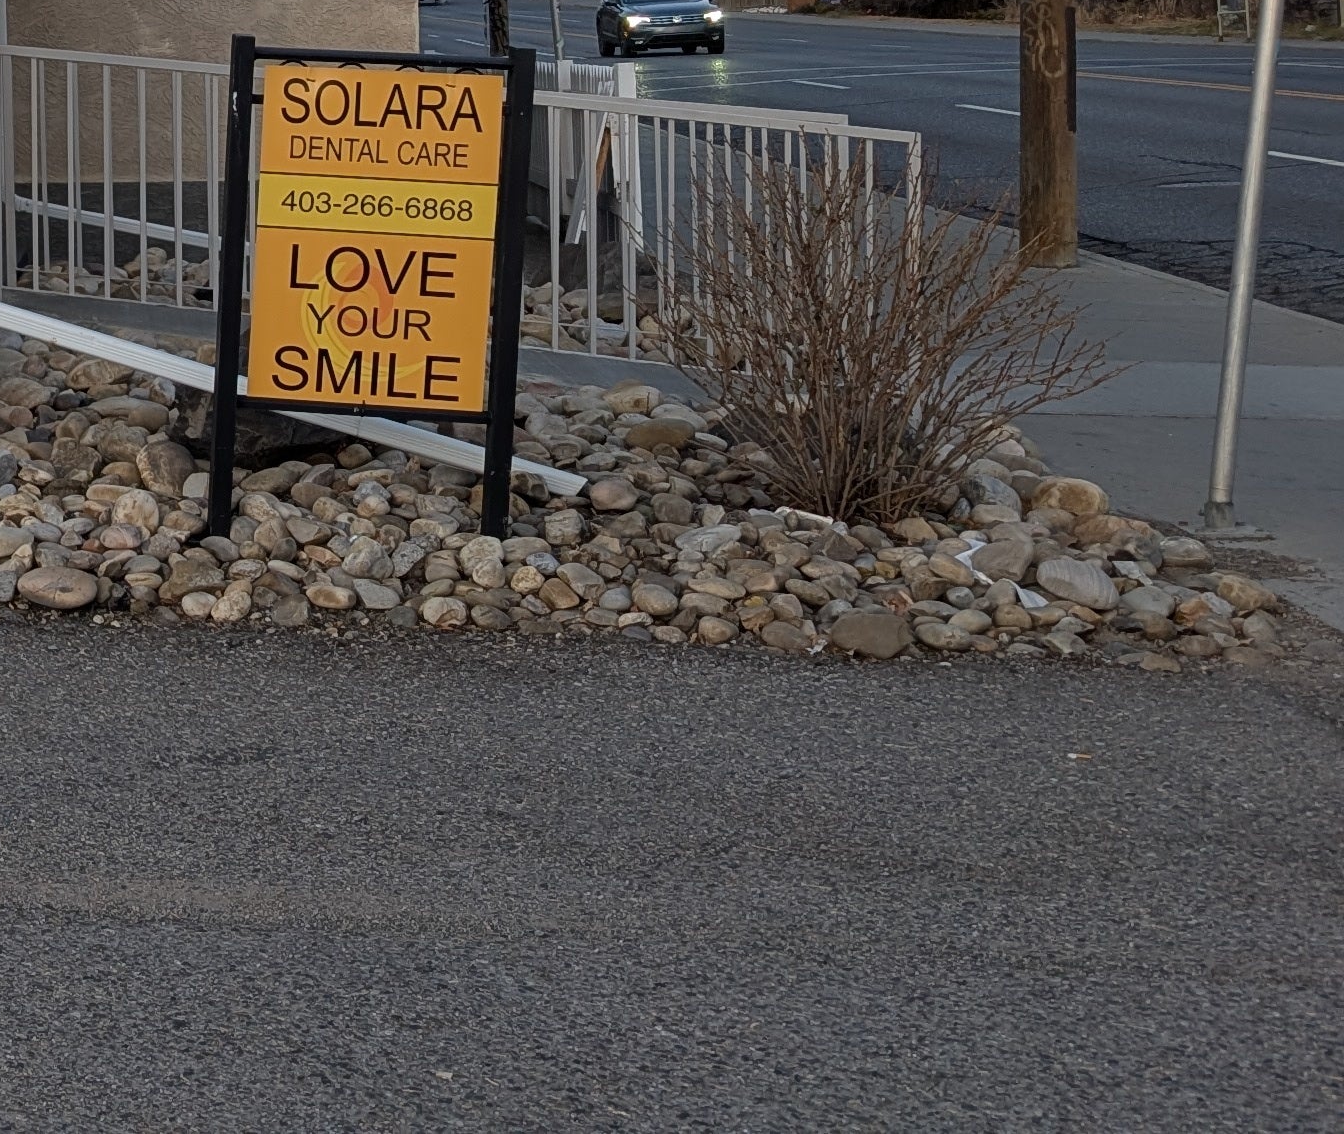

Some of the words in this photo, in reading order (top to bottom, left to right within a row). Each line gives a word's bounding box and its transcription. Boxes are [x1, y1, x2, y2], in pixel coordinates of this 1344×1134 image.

[280, 77, 484, 133] SOLARA
[289, 135, 388, 164] DENTAL
[397, 140, 469, 168] CARE
[281, 190, 473, 221] 403-266-6868
[289, 243, 457, 298] LOVE
[307, 302, 432, 341] YOUR
[271, 345, 461, 402] SMILE
